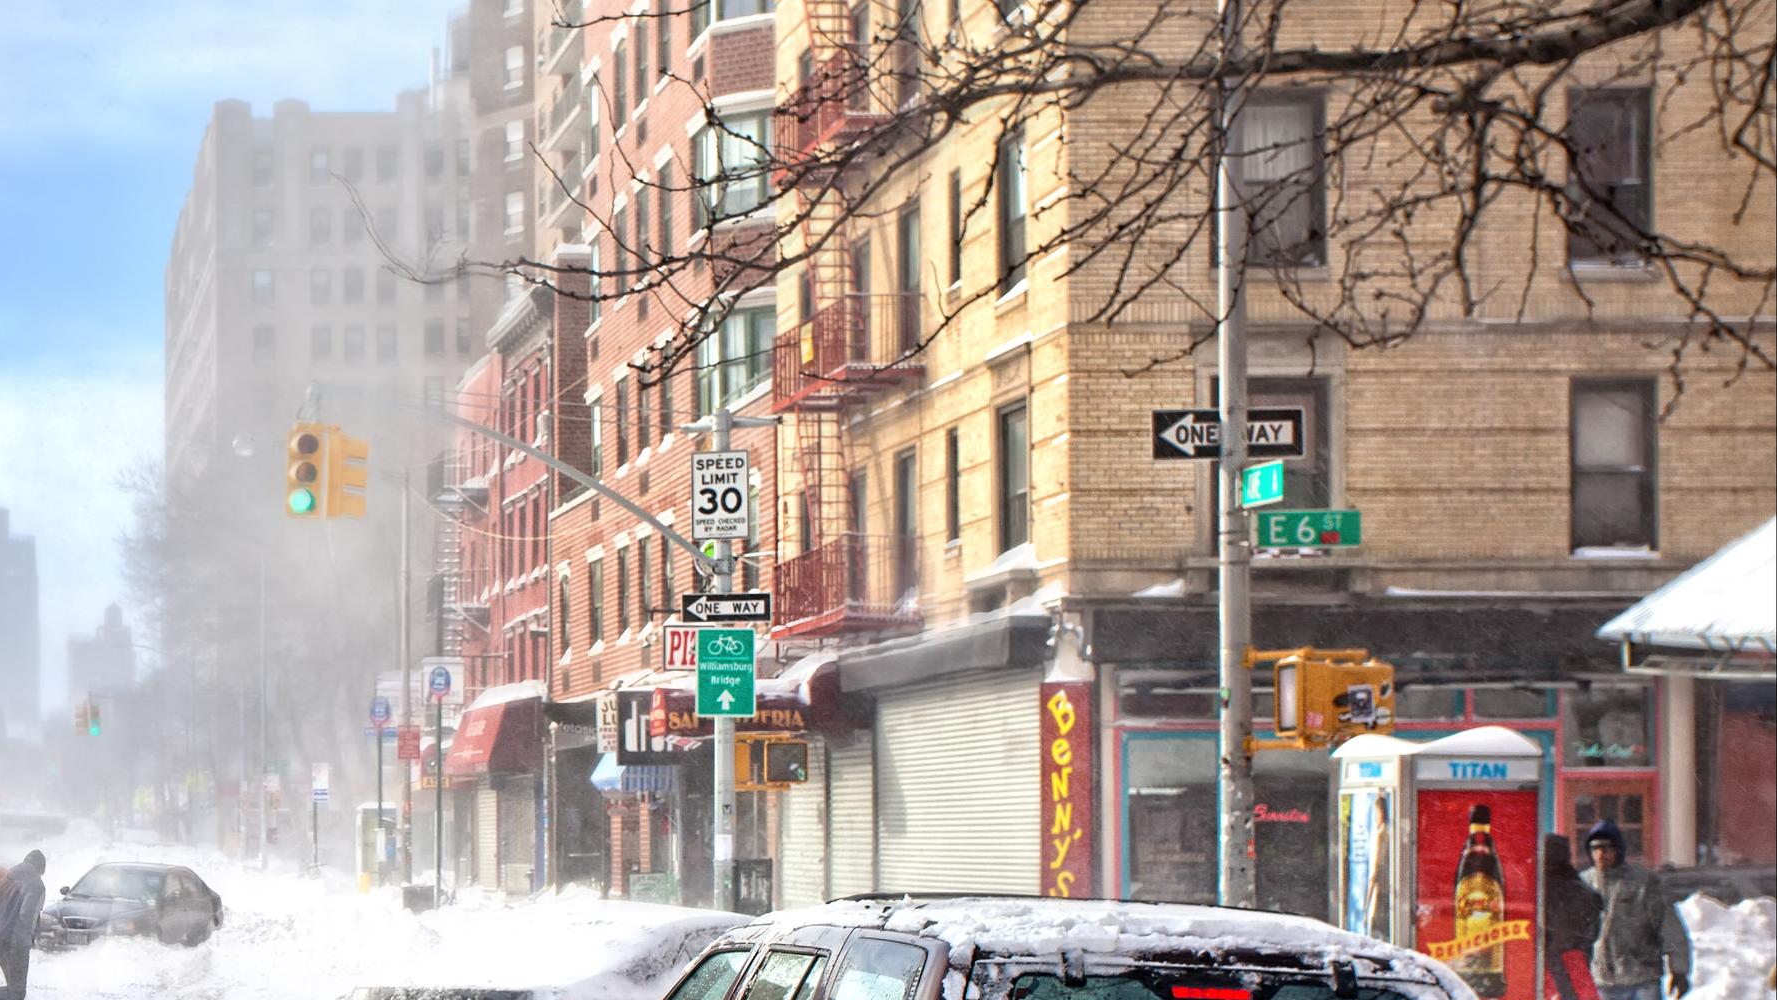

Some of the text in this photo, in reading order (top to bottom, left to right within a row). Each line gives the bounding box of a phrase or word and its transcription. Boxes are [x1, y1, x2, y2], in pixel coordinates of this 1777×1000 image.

[1176, 424, 1218, 444] ONE
[696, 458, 745, 470] SPEED
[701, 473, 738, 485] LIMIT
[698, 487, 742, 515] 30
[1269, 515, 1286, 543] E
[1297, 516, 1316, 542] 6
[1323, 512, 1342, 530] ST
[696, 601, 760, 614] ONE WAY
[699, 662, 753, 673] Williamsburg
[710, 676, 741, 685] Bridge
[1448, 762, 1508, 779] TITAN
